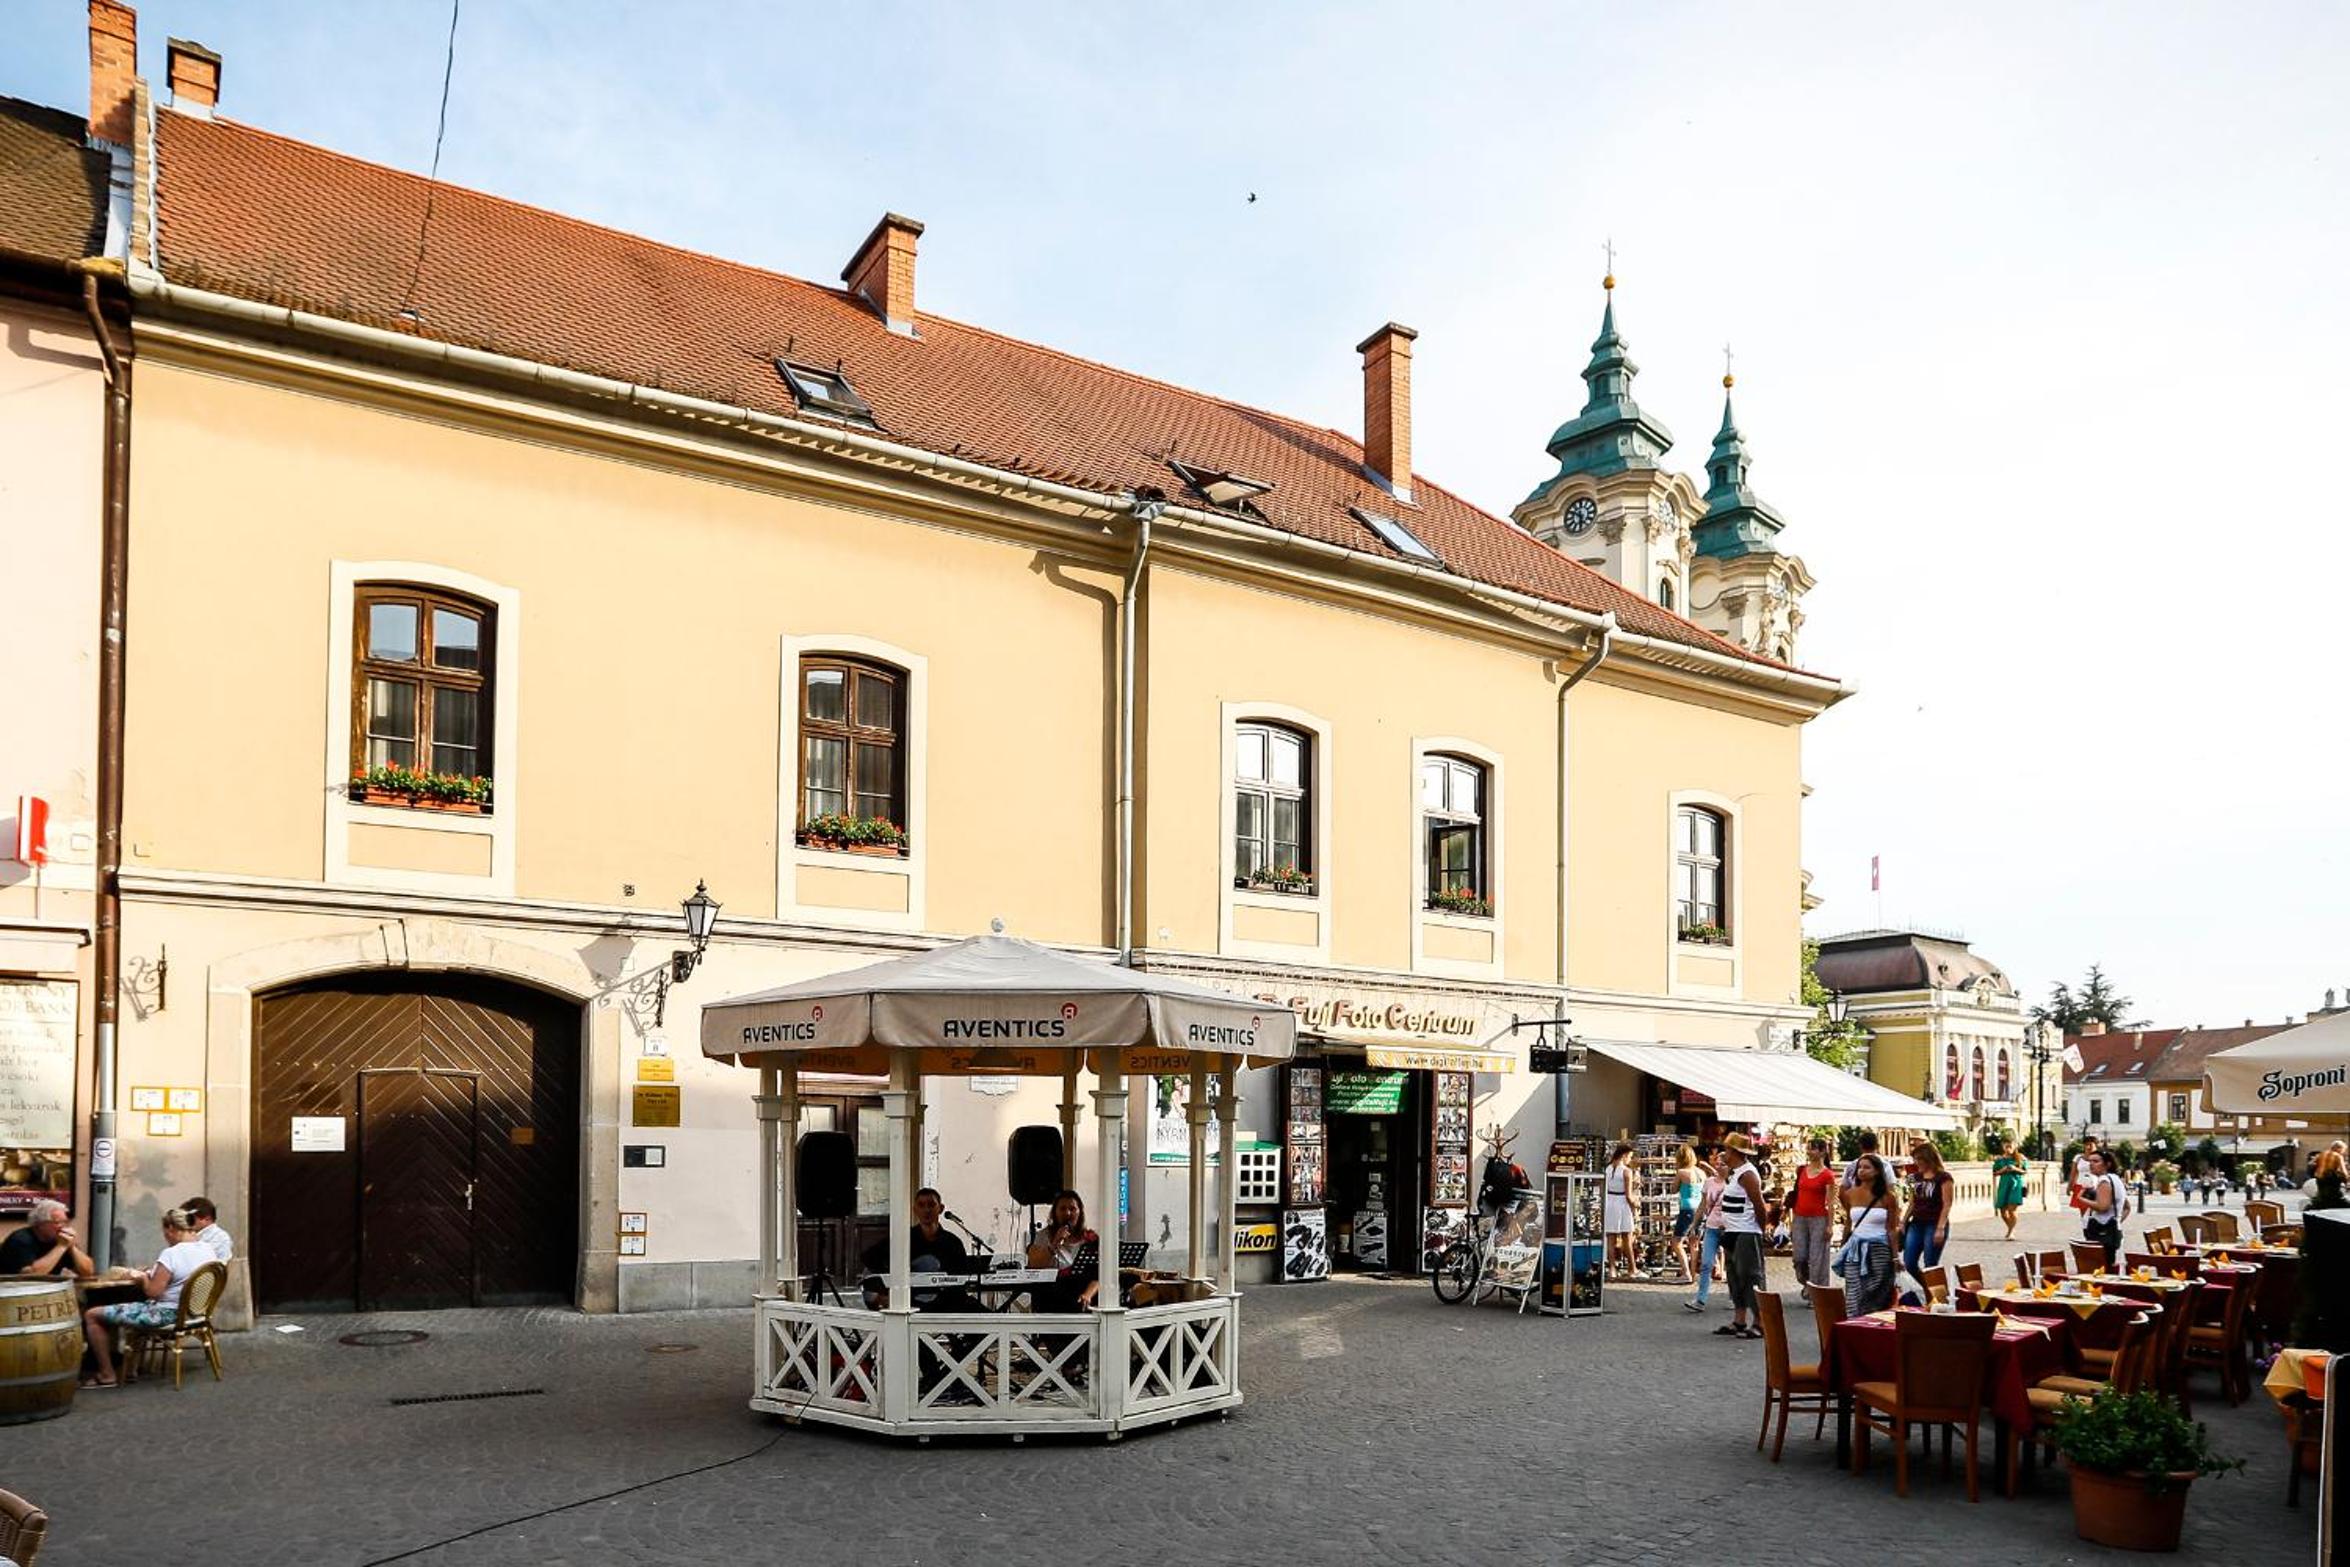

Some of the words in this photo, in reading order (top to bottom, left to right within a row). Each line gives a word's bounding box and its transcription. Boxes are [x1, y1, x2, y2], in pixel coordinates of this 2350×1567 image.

[1290, 997, 1333, 1031] Fuji
[1333, 1000, 1386, 1029] Foto
[1385, 1003, 1475, 1036] Centrum
[743, 1023, 815, 1043] AVENTICS
[944, 1020, 1065, 1038] AVENTICS
[1189, 1024, 1255, 1046] AVENTICS
[2257, 1064, 2346, 1102] Soproni
